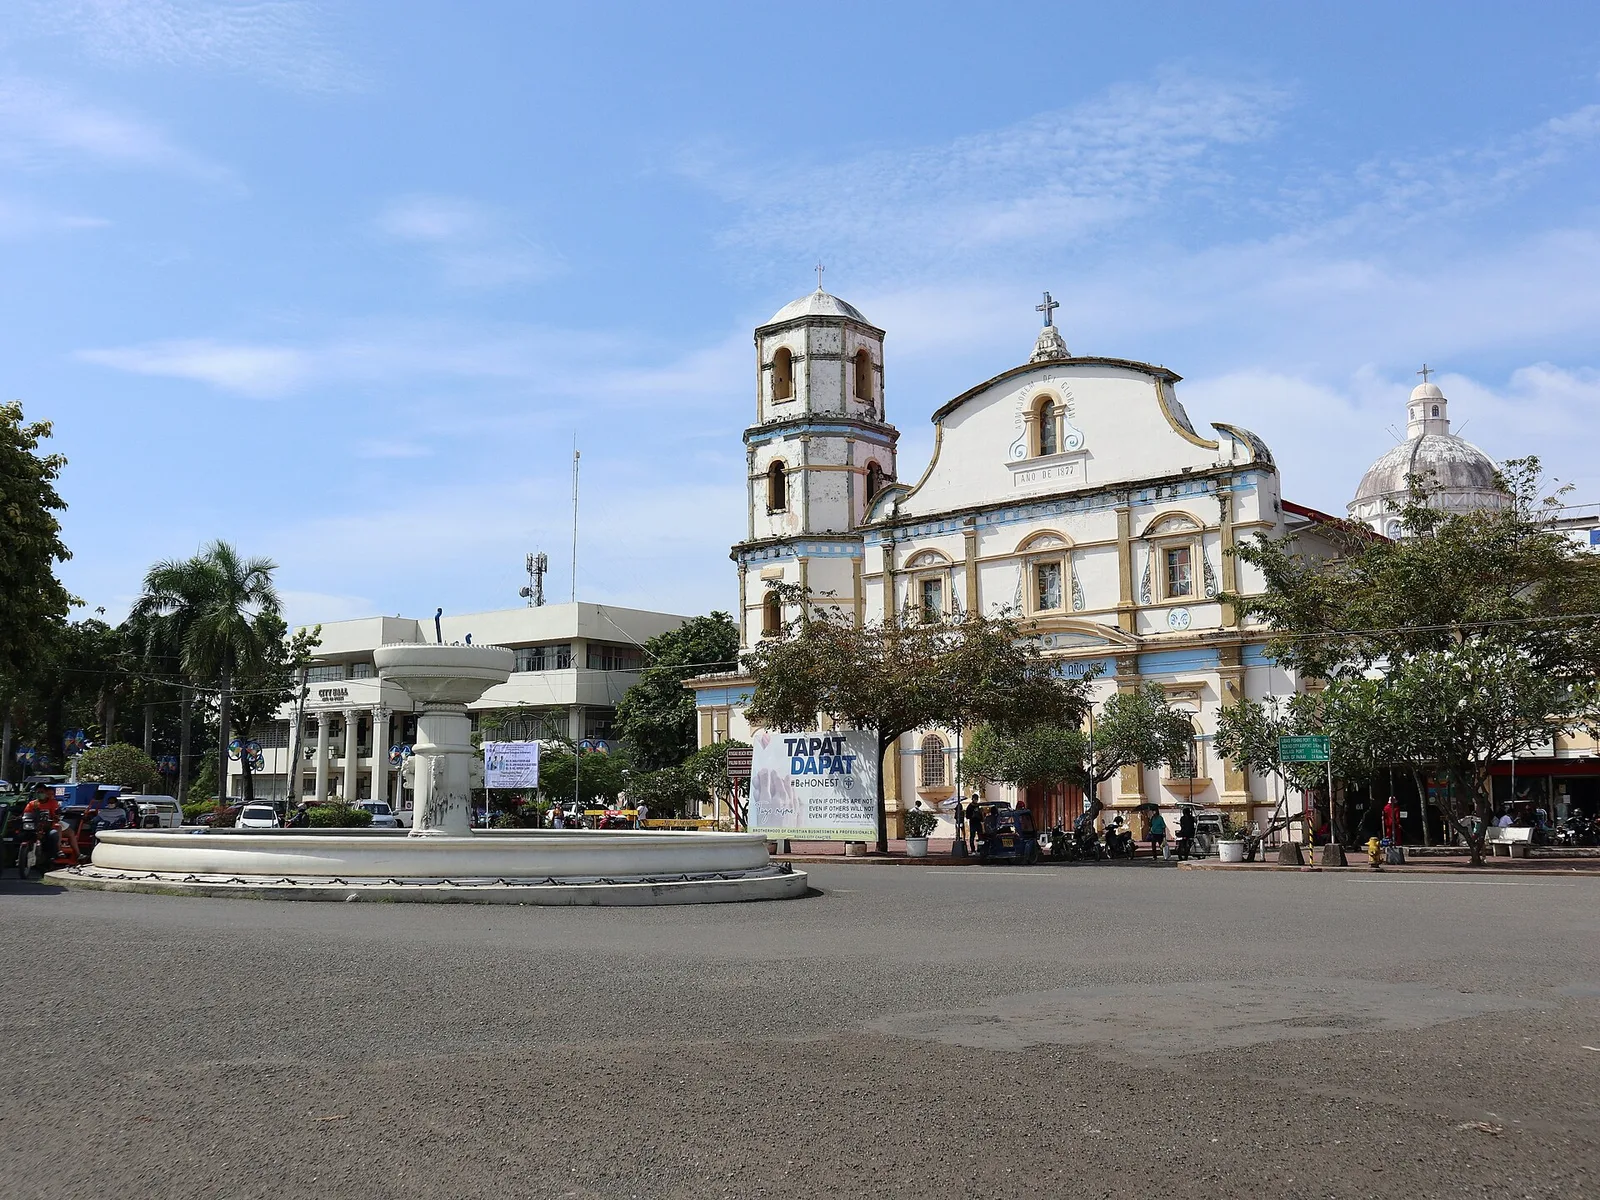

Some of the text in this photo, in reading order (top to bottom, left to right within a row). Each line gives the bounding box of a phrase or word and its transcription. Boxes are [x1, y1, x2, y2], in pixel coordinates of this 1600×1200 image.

[1020, 466, 1074, 483] AÑO DE 1877
[1068, 662, 1084, 676] AÑO
[318, 688, 349, 697] CITY HALL
[784, 737, 846, 756] TAPAT
[791, 755, 857, 775] DAPAT
[790, 778, 839, 788] #BeHONEST
